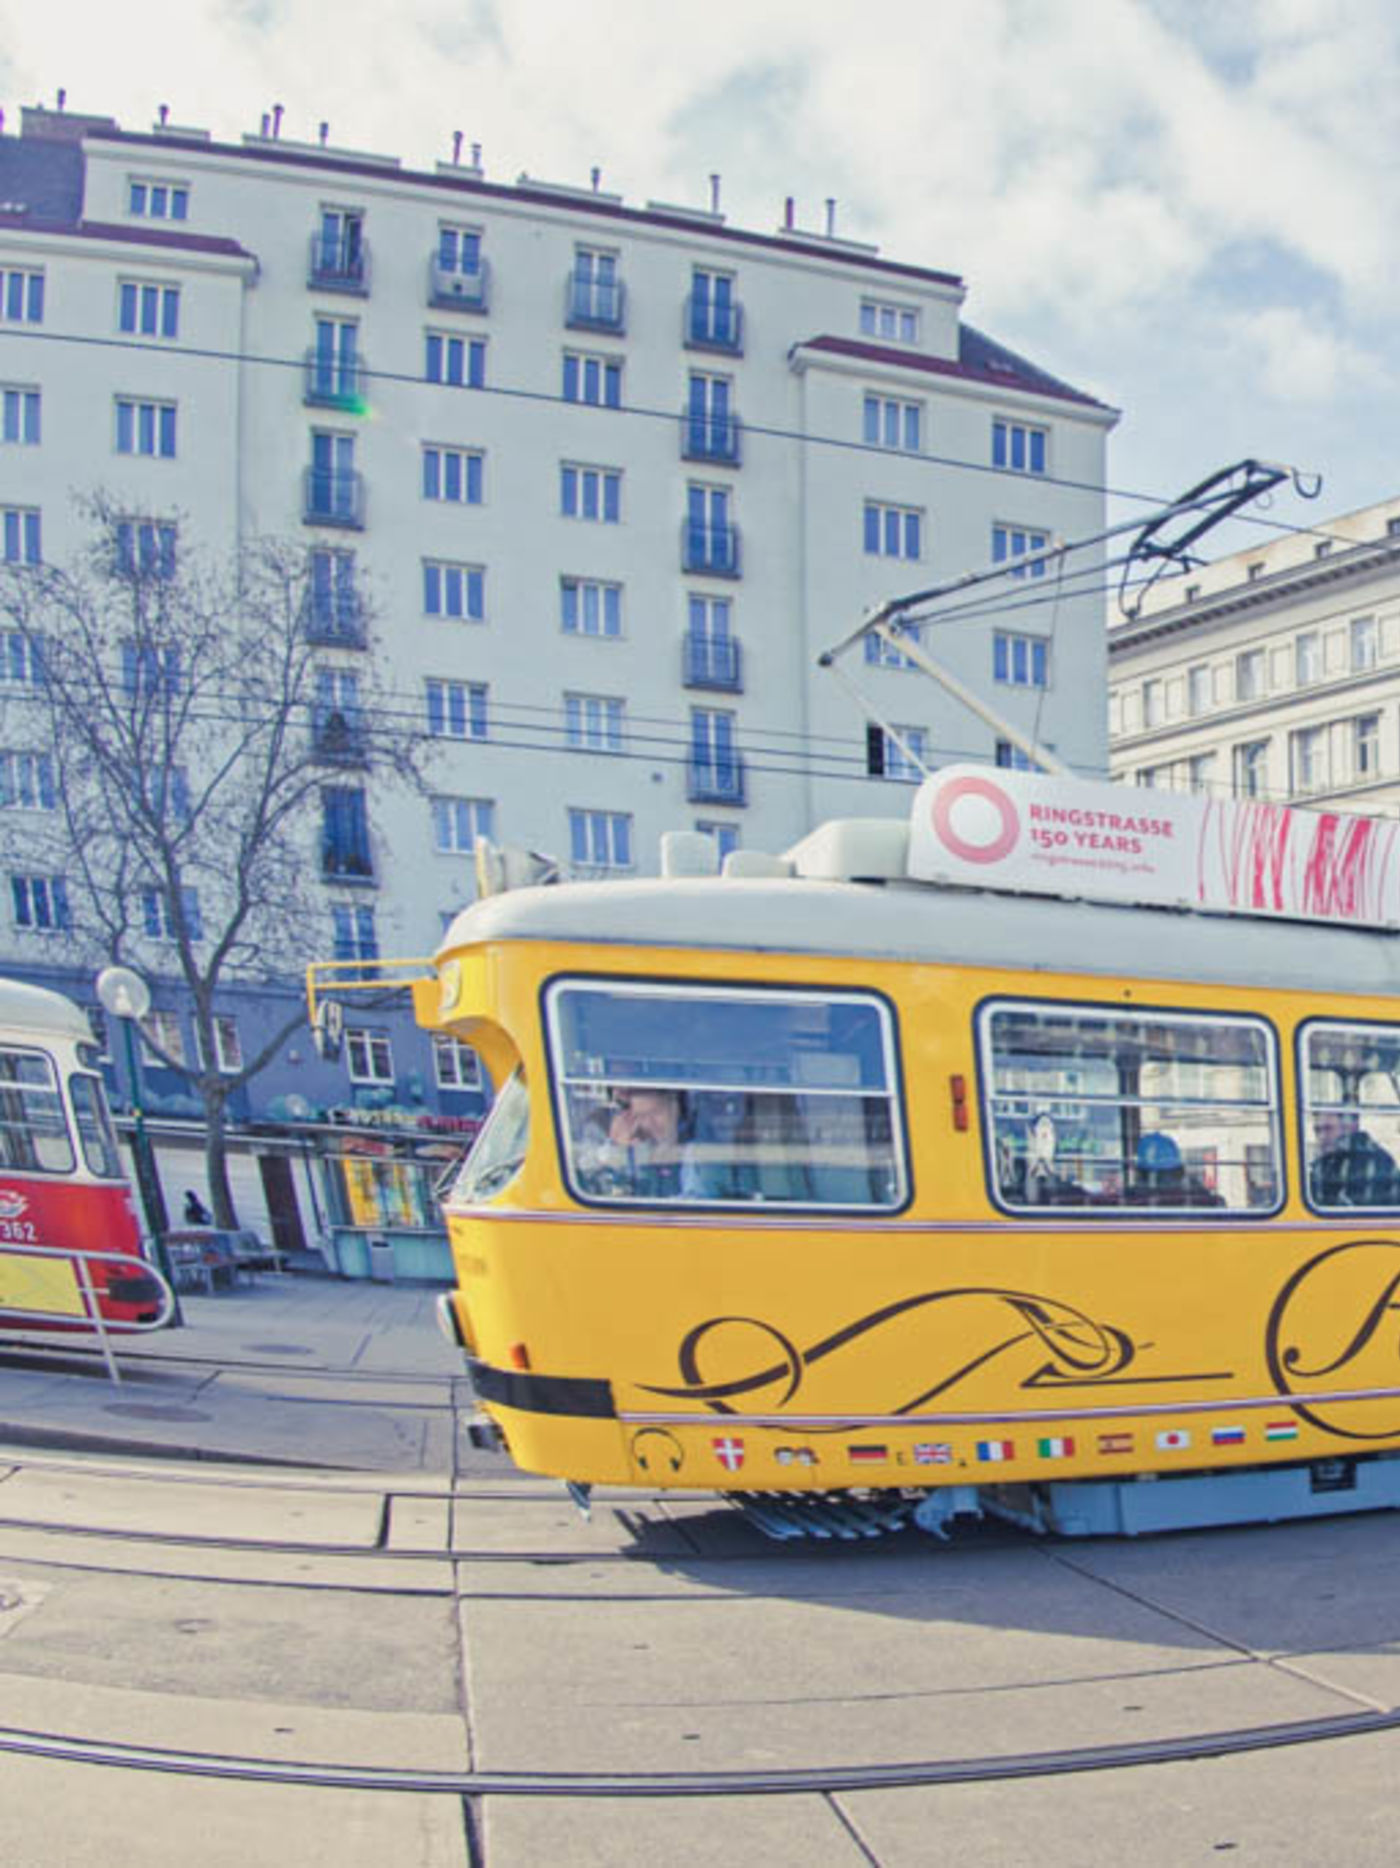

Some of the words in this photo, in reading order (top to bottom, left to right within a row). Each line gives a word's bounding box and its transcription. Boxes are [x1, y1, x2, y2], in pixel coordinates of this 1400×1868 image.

[1029, 803, 1174, 838] RINGSTRASSE
[1030, 828, 1068, 848] 150
[1074, 832, 1142, 853] YEARS
